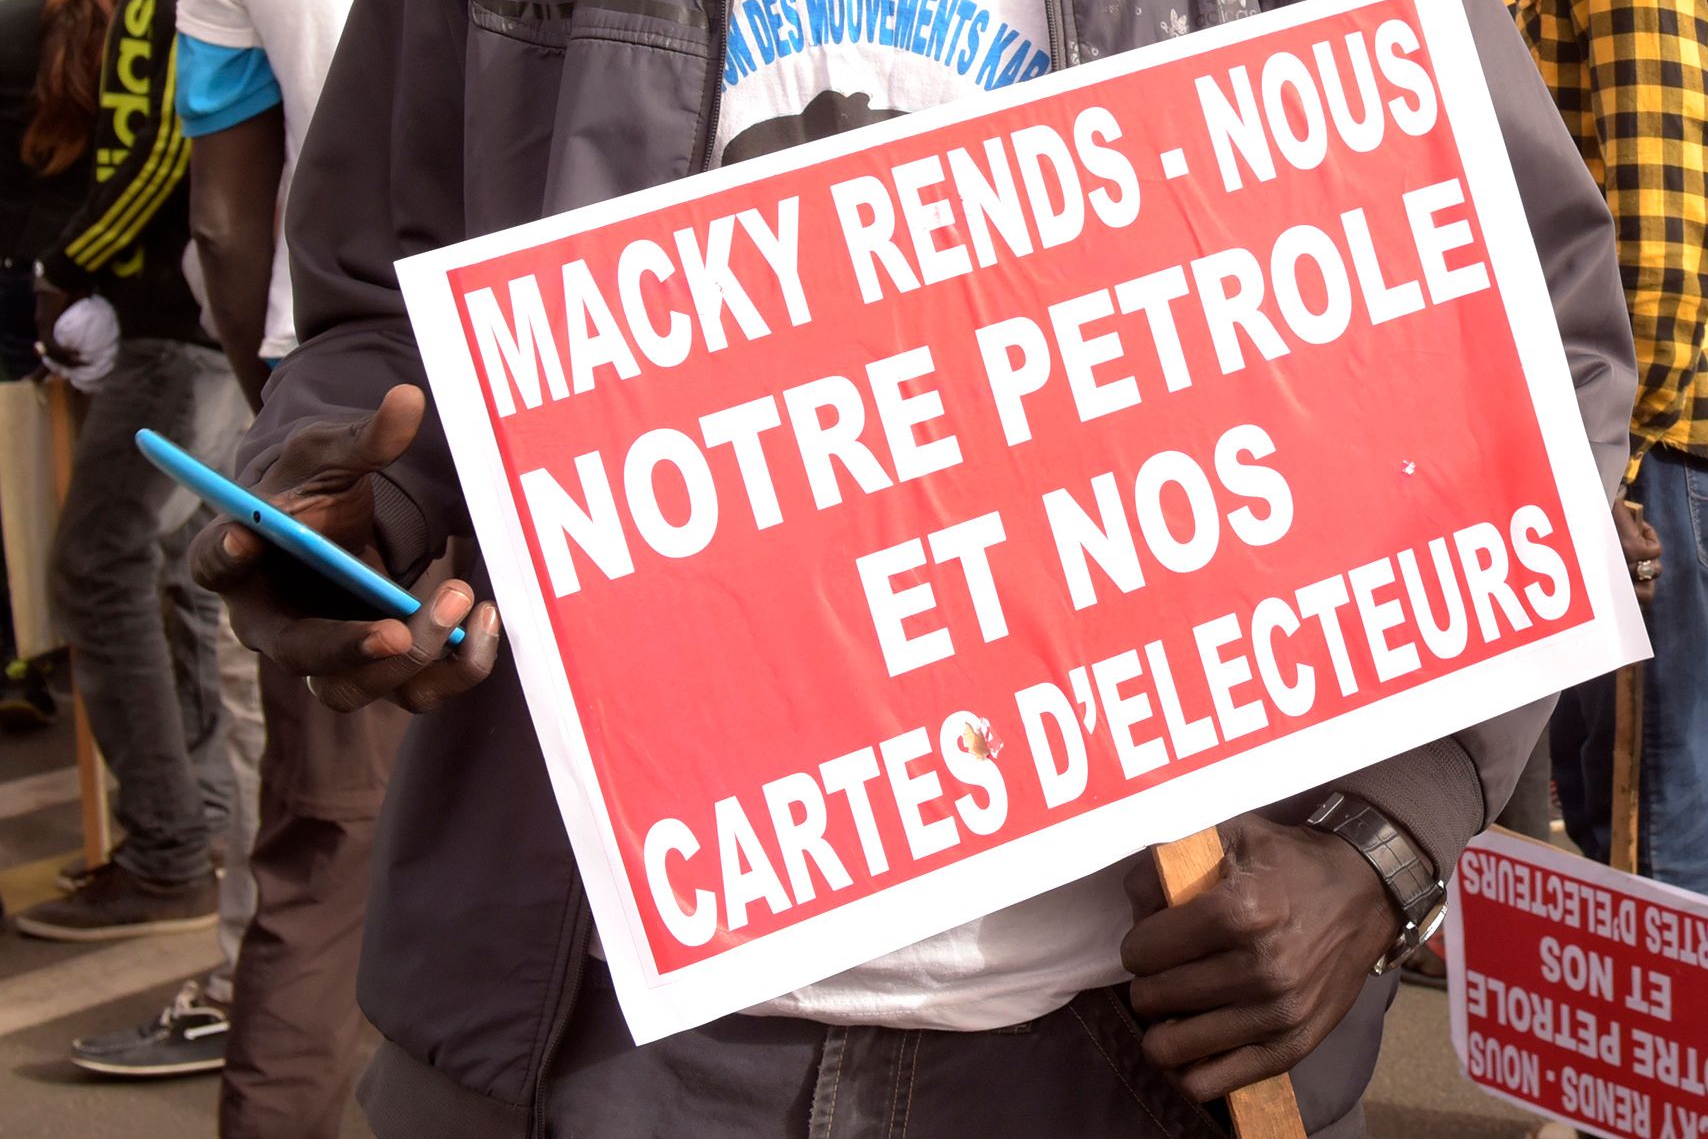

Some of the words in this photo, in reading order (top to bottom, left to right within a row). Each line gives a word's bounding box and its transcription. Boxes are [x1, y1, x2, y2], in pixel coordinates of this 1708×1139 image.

[464, 196, 812, 418] MACKY
[830, 107, 1140, 304] RENDS
[1195, 19, 1437, 192] NOUS
[520, 346, 963, 598] NOTRE
[975, 178, 1490, 446] PETROLE
[856, 511, 1009, 677] ET
[1042, 424, 1293, 610] NOS
[644, 711, 1008, 946] CARTES
[1015, 505, 1570, 809] D'ELECTEURS
[1462, 852, 1636, 946] D'ELECTEURS
[1540, 936, 1612, 1001] NOS
[1626, 967, 1671, 1021] ET
[1467, 970, 1620, 1066] PETROLE
[1467, 1031, 1539, 1097] NOUS
[1562, 1067, 1650, 1138] RENDS
